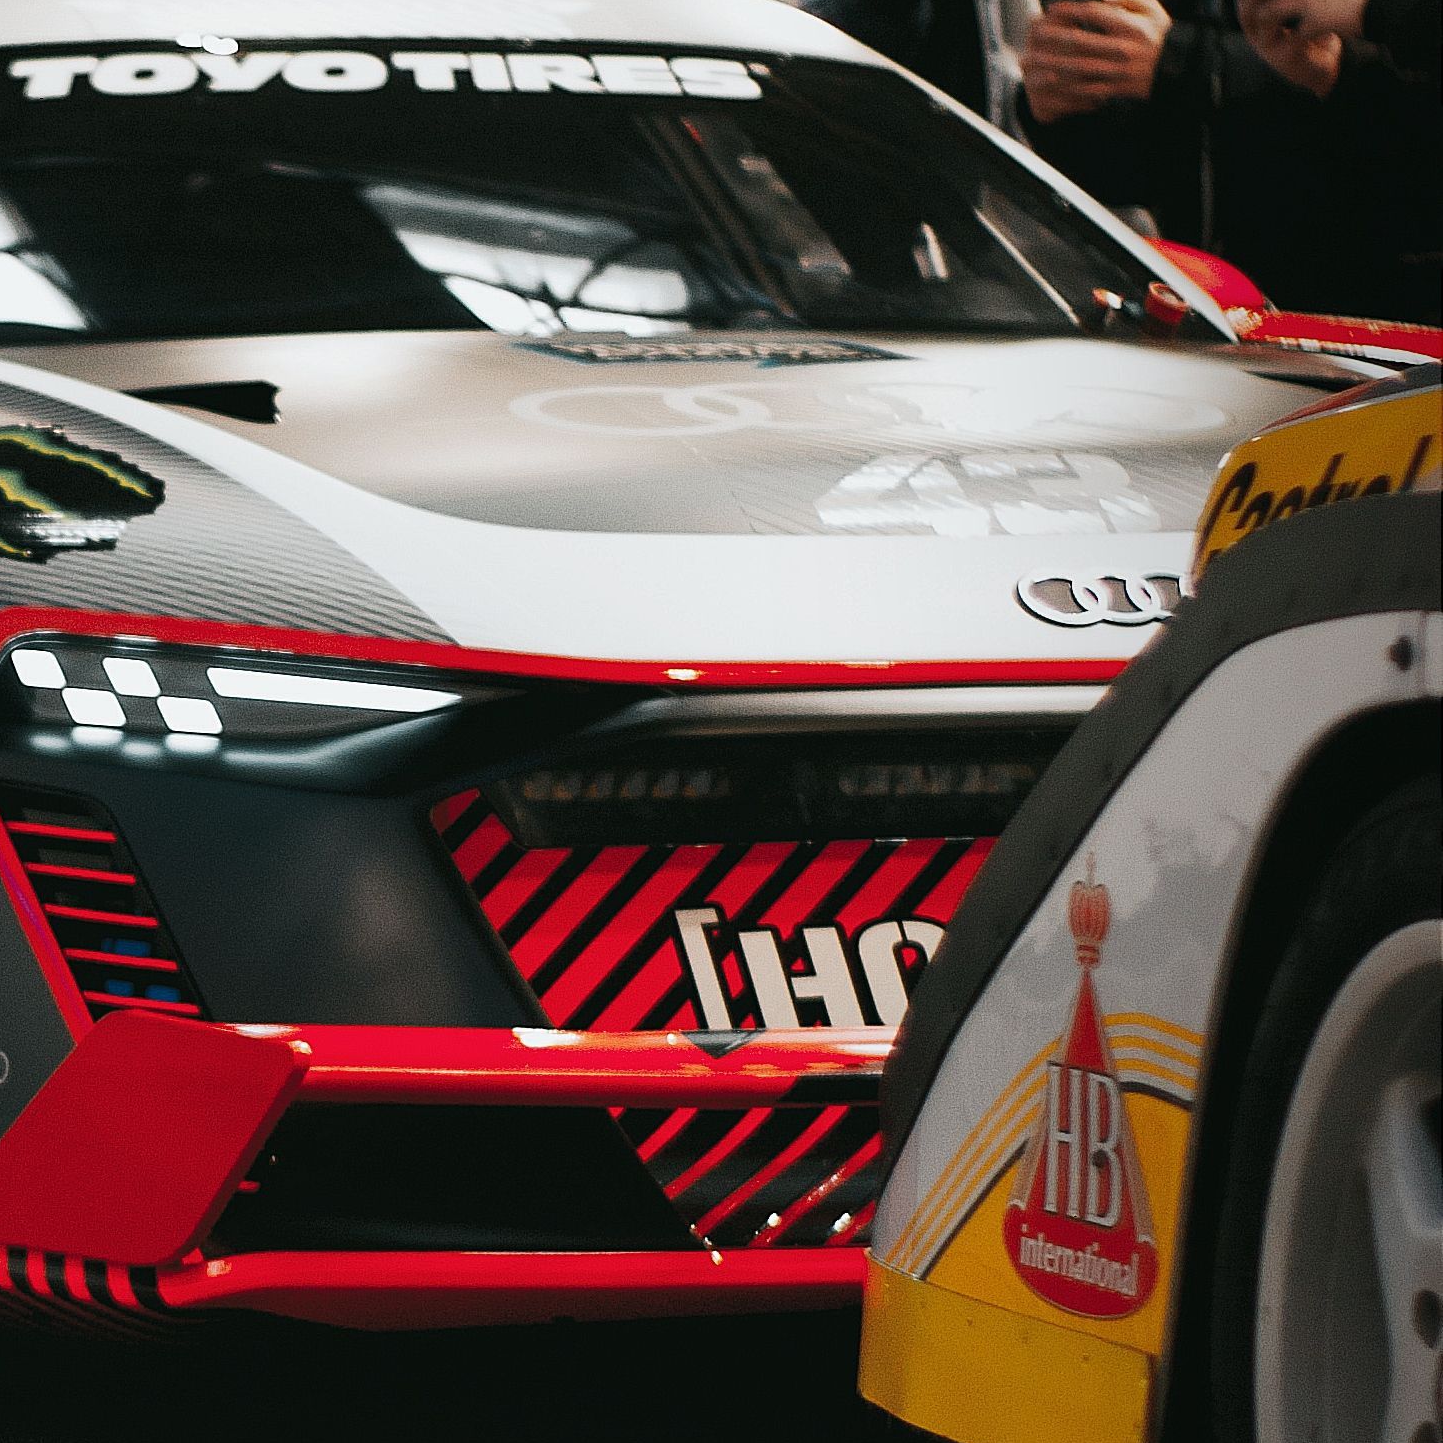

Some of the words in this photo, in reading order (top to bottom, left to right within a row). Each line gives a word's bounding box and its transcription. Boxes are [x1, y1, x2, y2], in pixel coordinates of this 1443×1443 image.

[9, 50, 389, 101] TOYO
[390, 50, 763, 100] TIRES
[1043, 1062, 1123, 1229] HB
[1020, 1222, 1140, 1298] international
